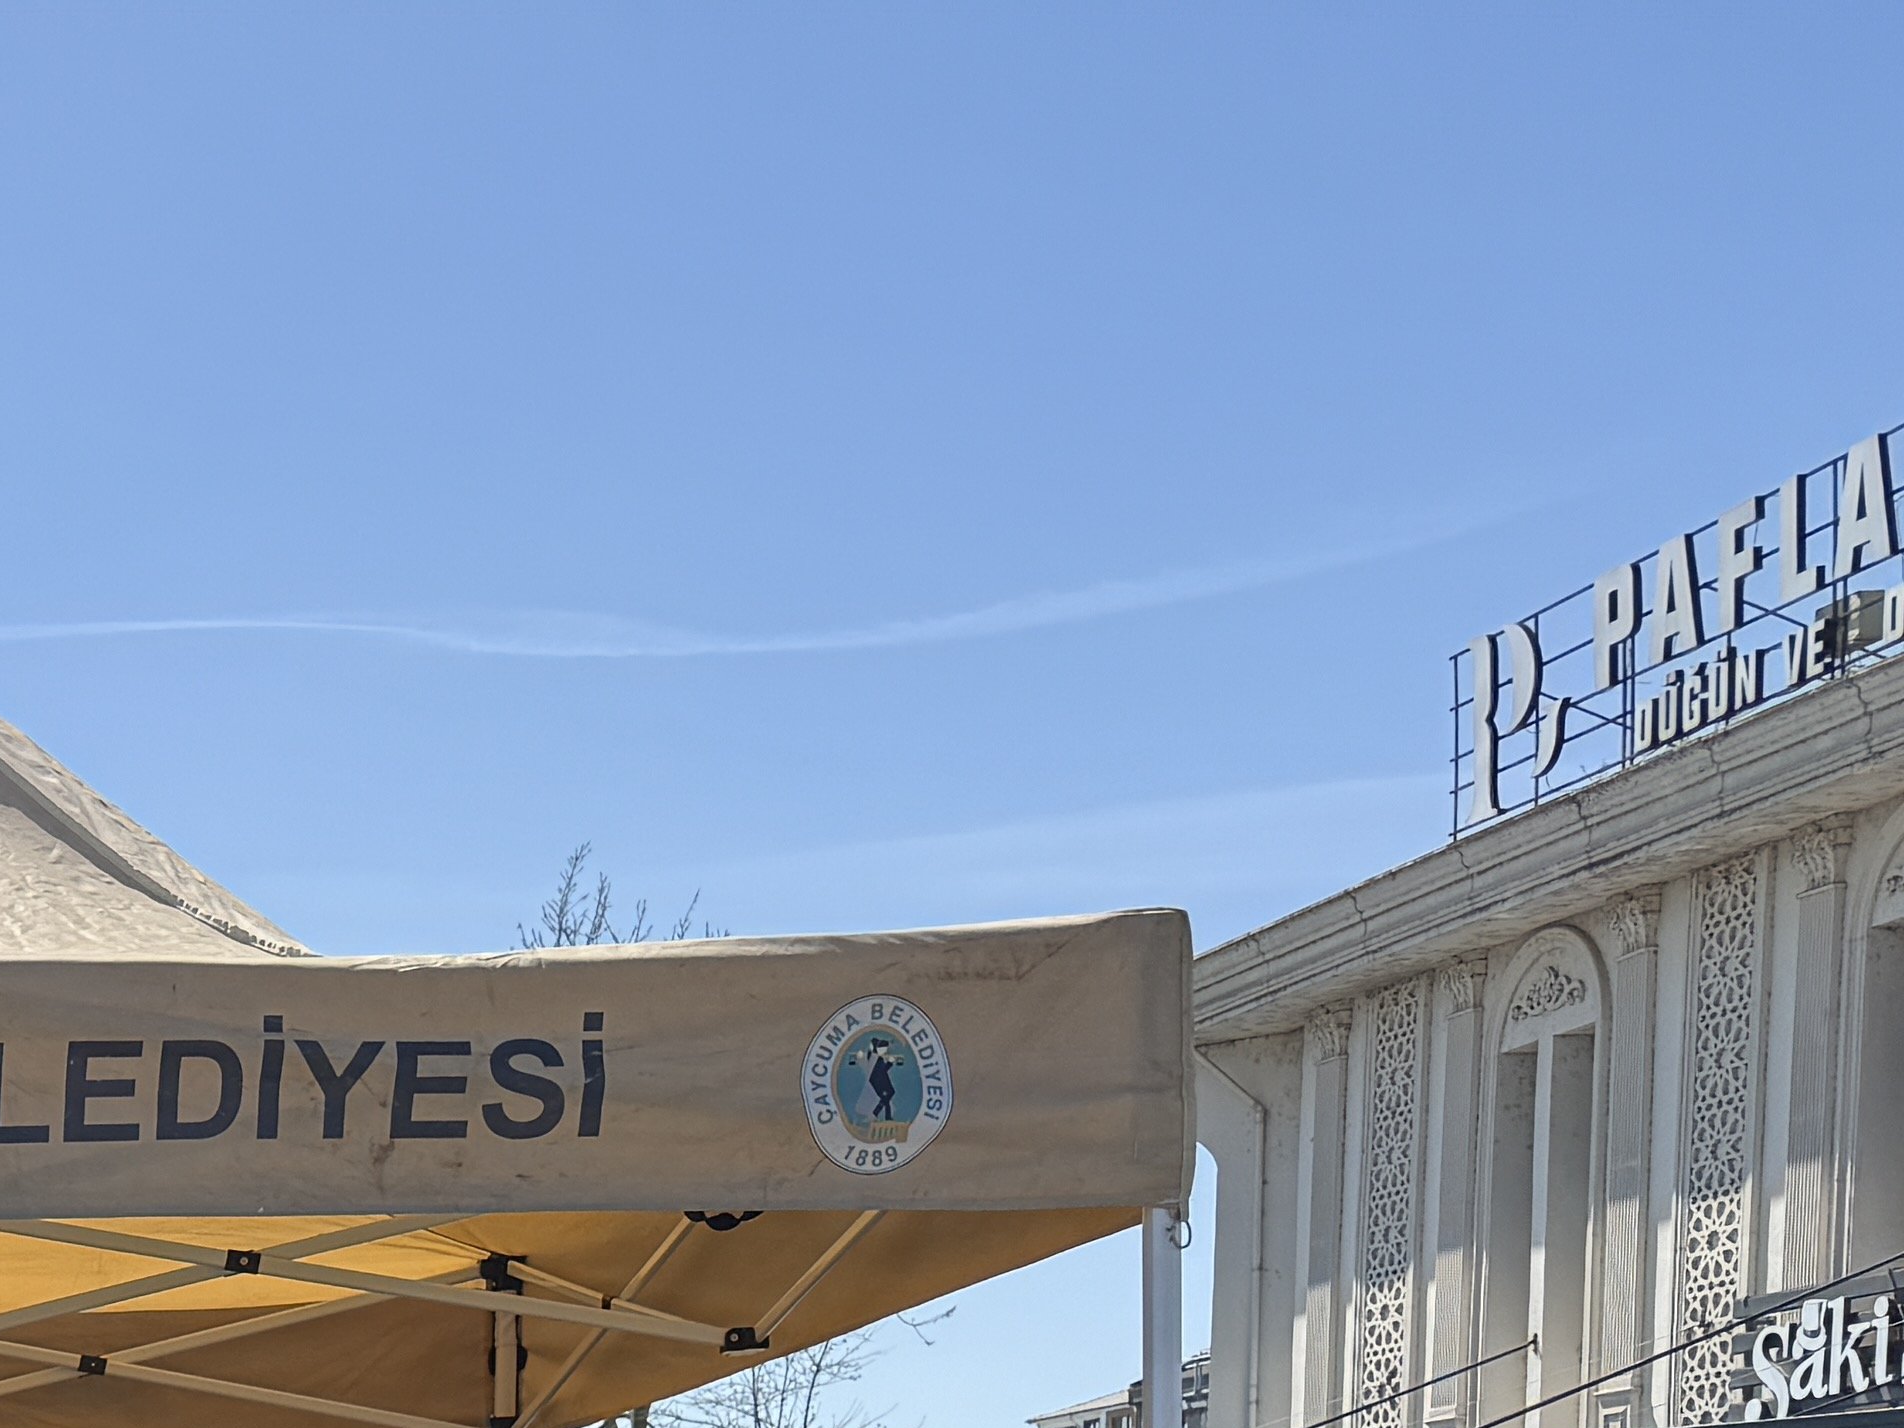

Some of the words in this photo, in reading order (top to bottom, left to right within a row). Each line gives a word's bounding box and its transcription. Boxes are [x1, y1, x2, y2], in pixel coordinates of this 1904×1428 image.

[1594, 432, 1896, 691] PAFLA
[1634, 646, 1762, 754] DÜĞÜN
[1781, 618, 1830, 685] VE
[810, 1013, 861, 1125] ÇAYCUMA
[870, 1003, 944, 1121] BELEDİYESİ
[843, 1145, 898, 1167] 1889
